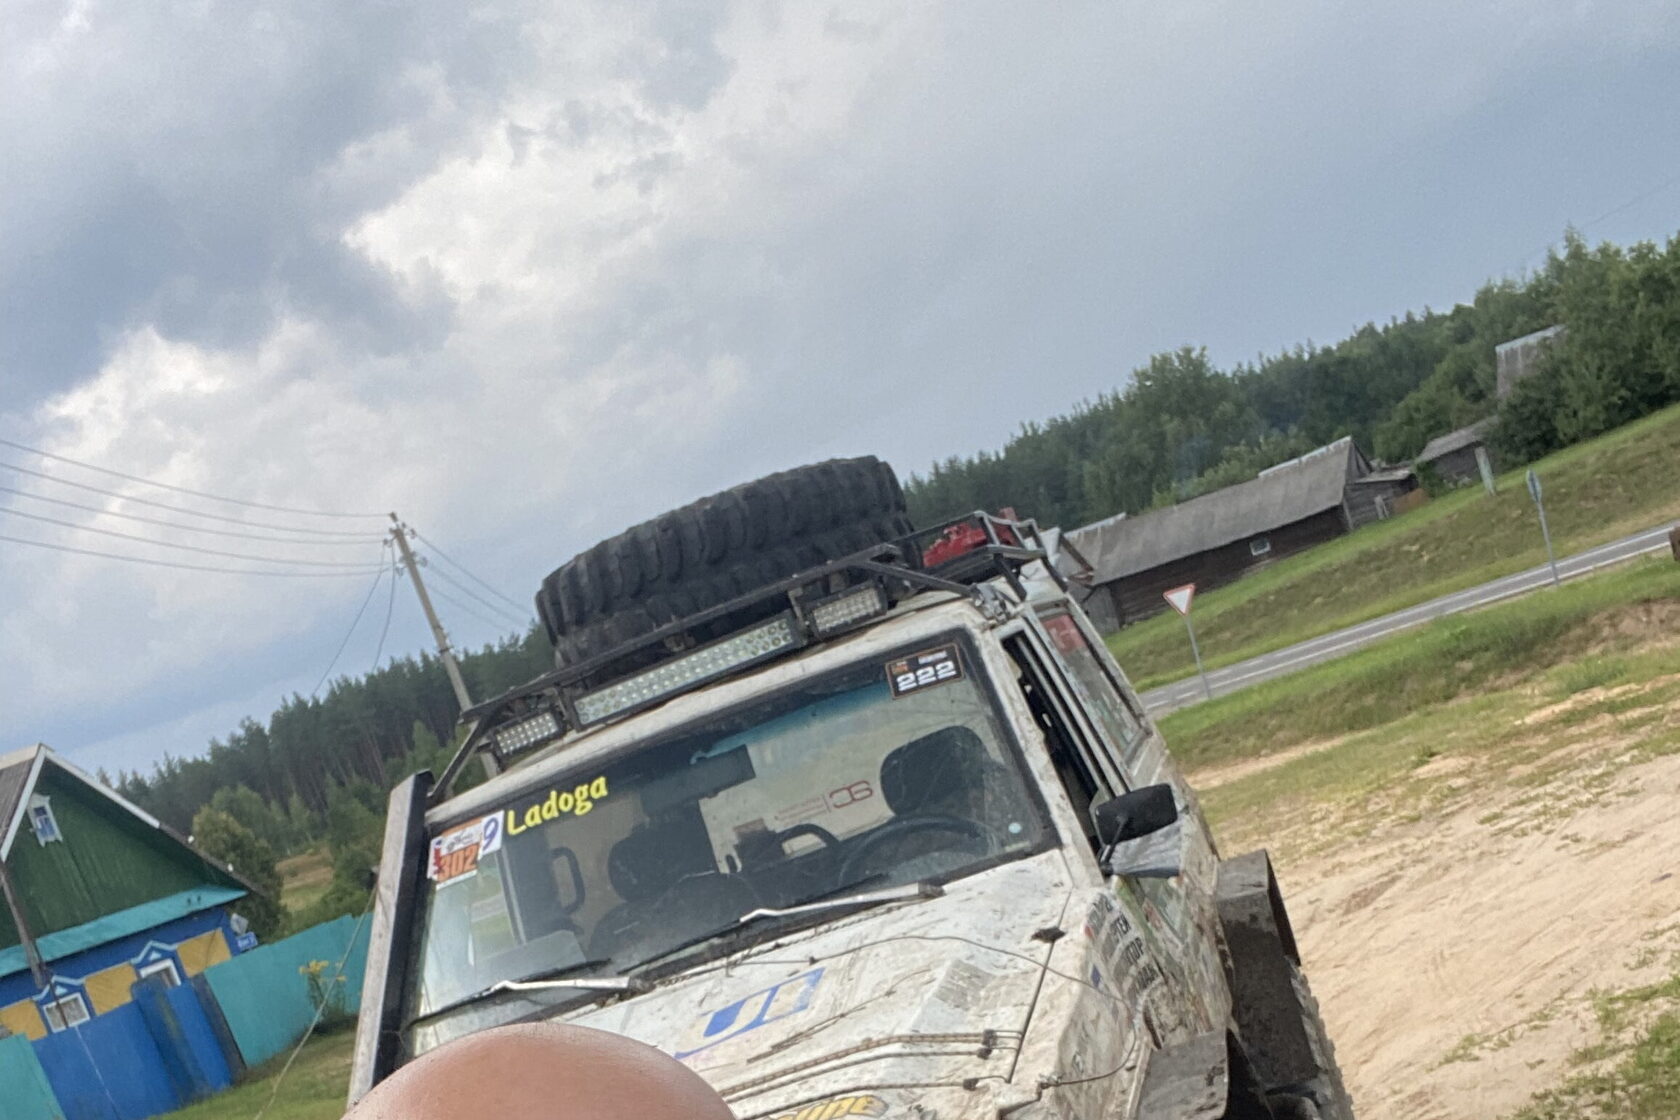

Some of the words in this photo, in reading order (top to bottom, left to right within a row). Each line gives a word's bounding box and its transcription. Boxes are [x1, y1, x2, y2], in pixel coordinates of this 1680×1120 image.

[896, 660, 957, 691] 222
[507, 776, 608, 835] Ladoga
[482, 816, 499, 852] 9
